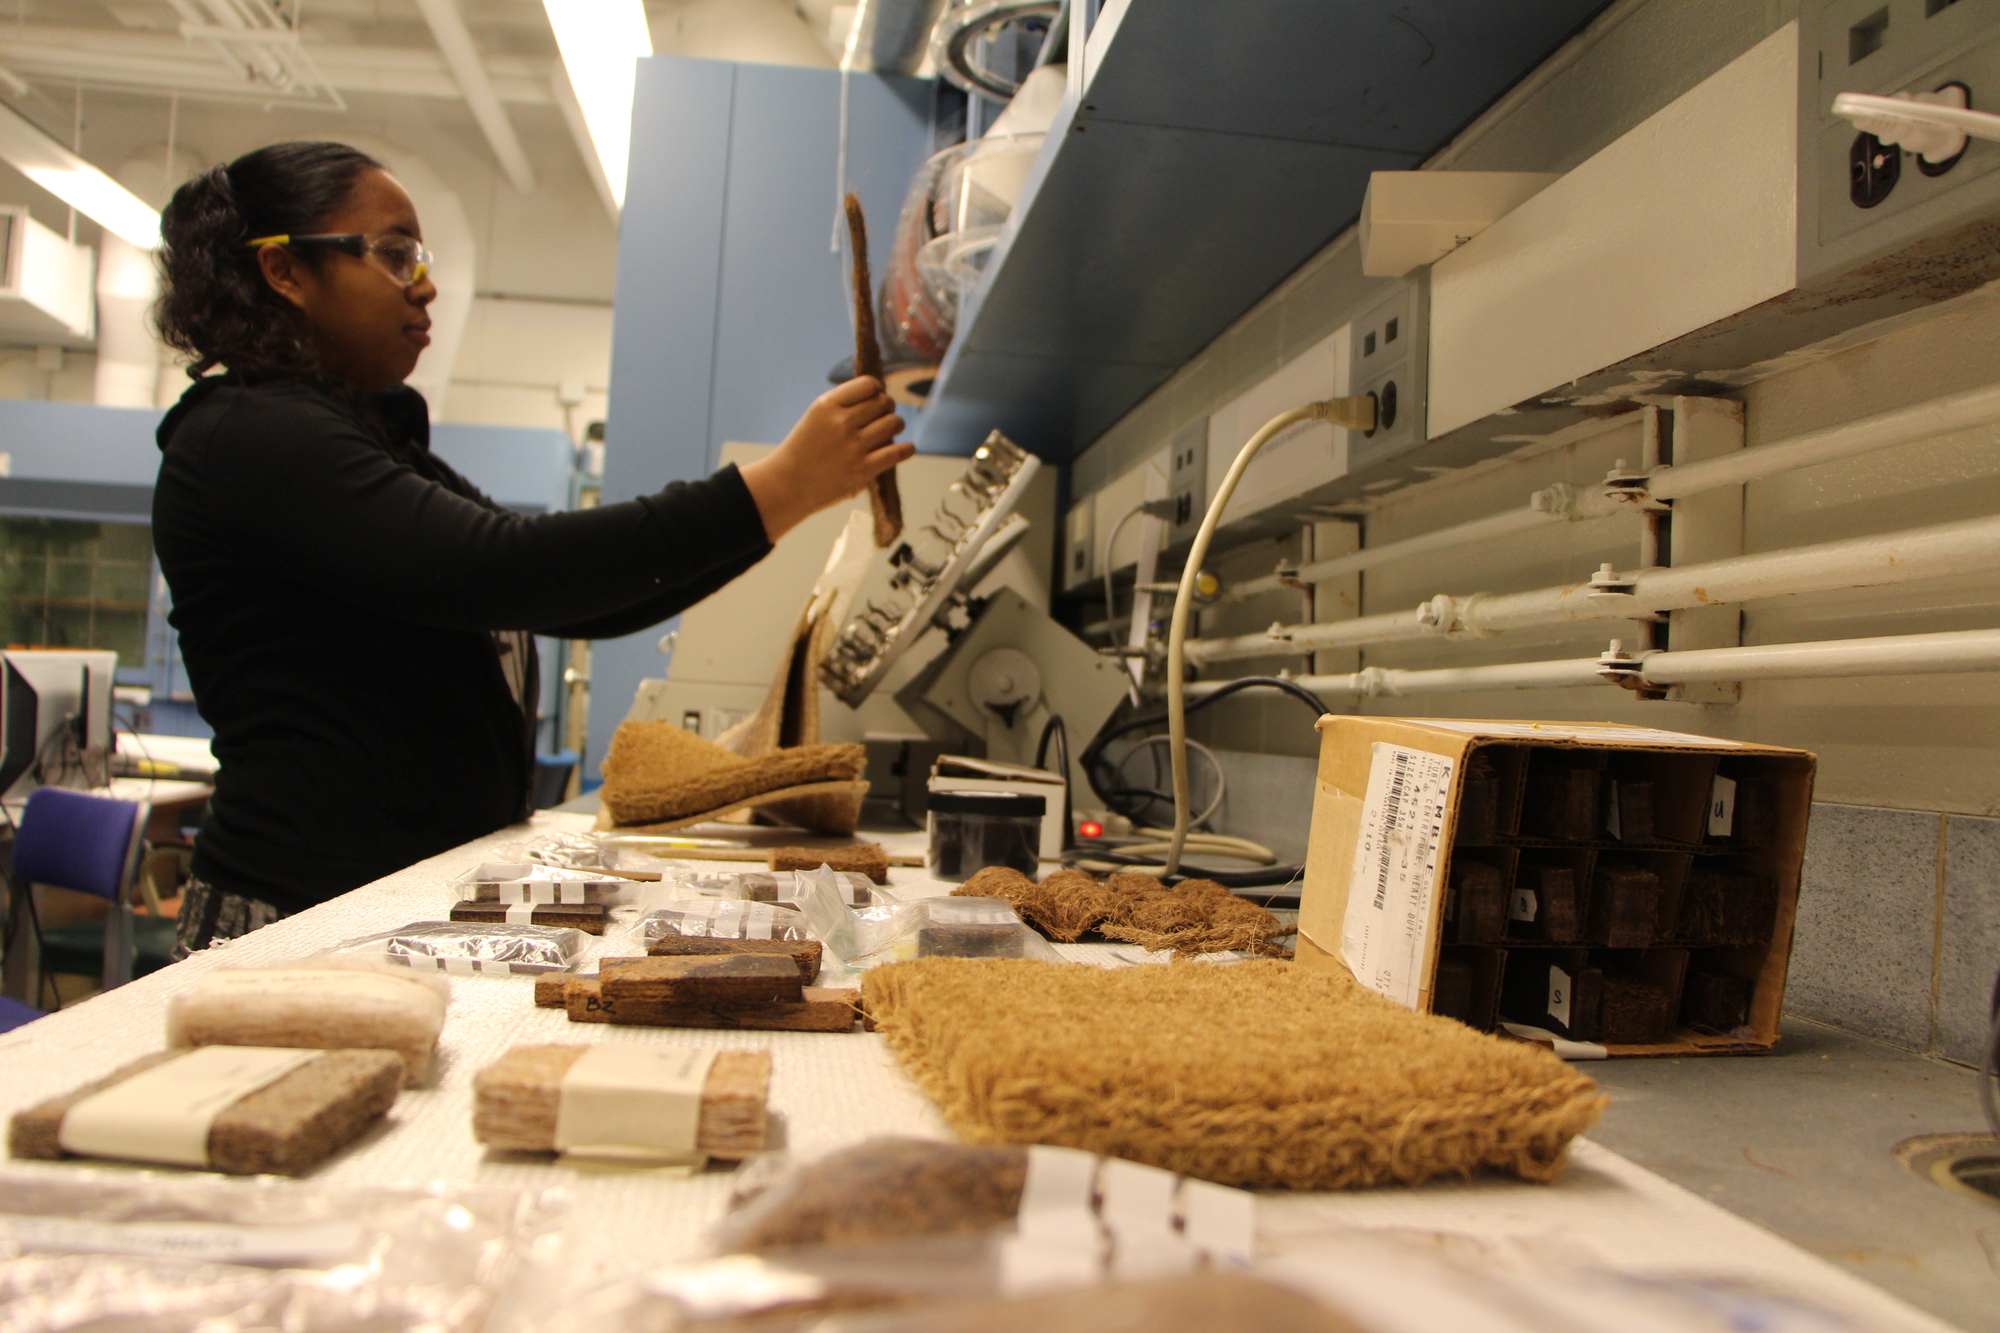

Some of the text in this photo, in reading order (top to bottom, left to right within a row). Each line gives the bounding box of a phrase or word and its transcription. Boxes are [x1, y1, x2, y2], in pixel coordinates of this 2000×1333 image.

[1402, 754, 1417, 804] SIZE/CAP
[1414, 798, 1433, 866] CENTRIFUGE,
[1425, 766, 1451, 878] KIMBLE
[1409, 874, 1421, 906] HEAVY
[1420, 880, 1429, 911] GLASS
[1405, 912, 1416, 939] DUTY
[1383, 970, 1391, 990] QTY
